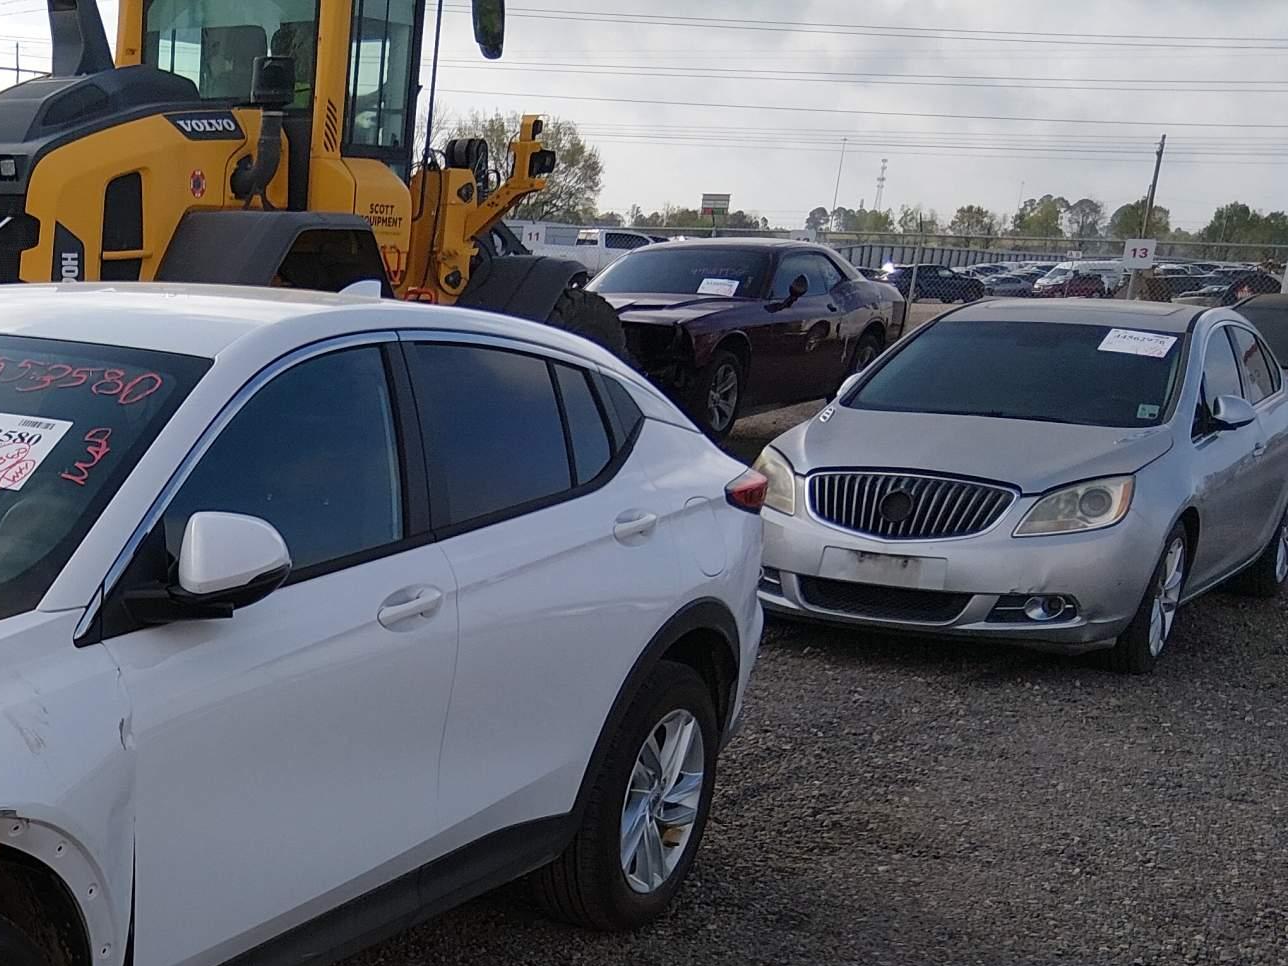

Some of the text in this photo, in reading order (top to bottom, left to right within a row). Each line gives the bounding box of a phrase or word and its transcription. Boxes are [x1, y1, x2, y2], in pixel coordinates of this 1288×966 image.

[176, 119, 235, 132] VOLVO
[369, 203, 394, 214] SCOTT
[361, 215, 403, 228] QUIPMENT
[527, 231, 540, 241] 11
[1130, 247, 1149, 259] 13
